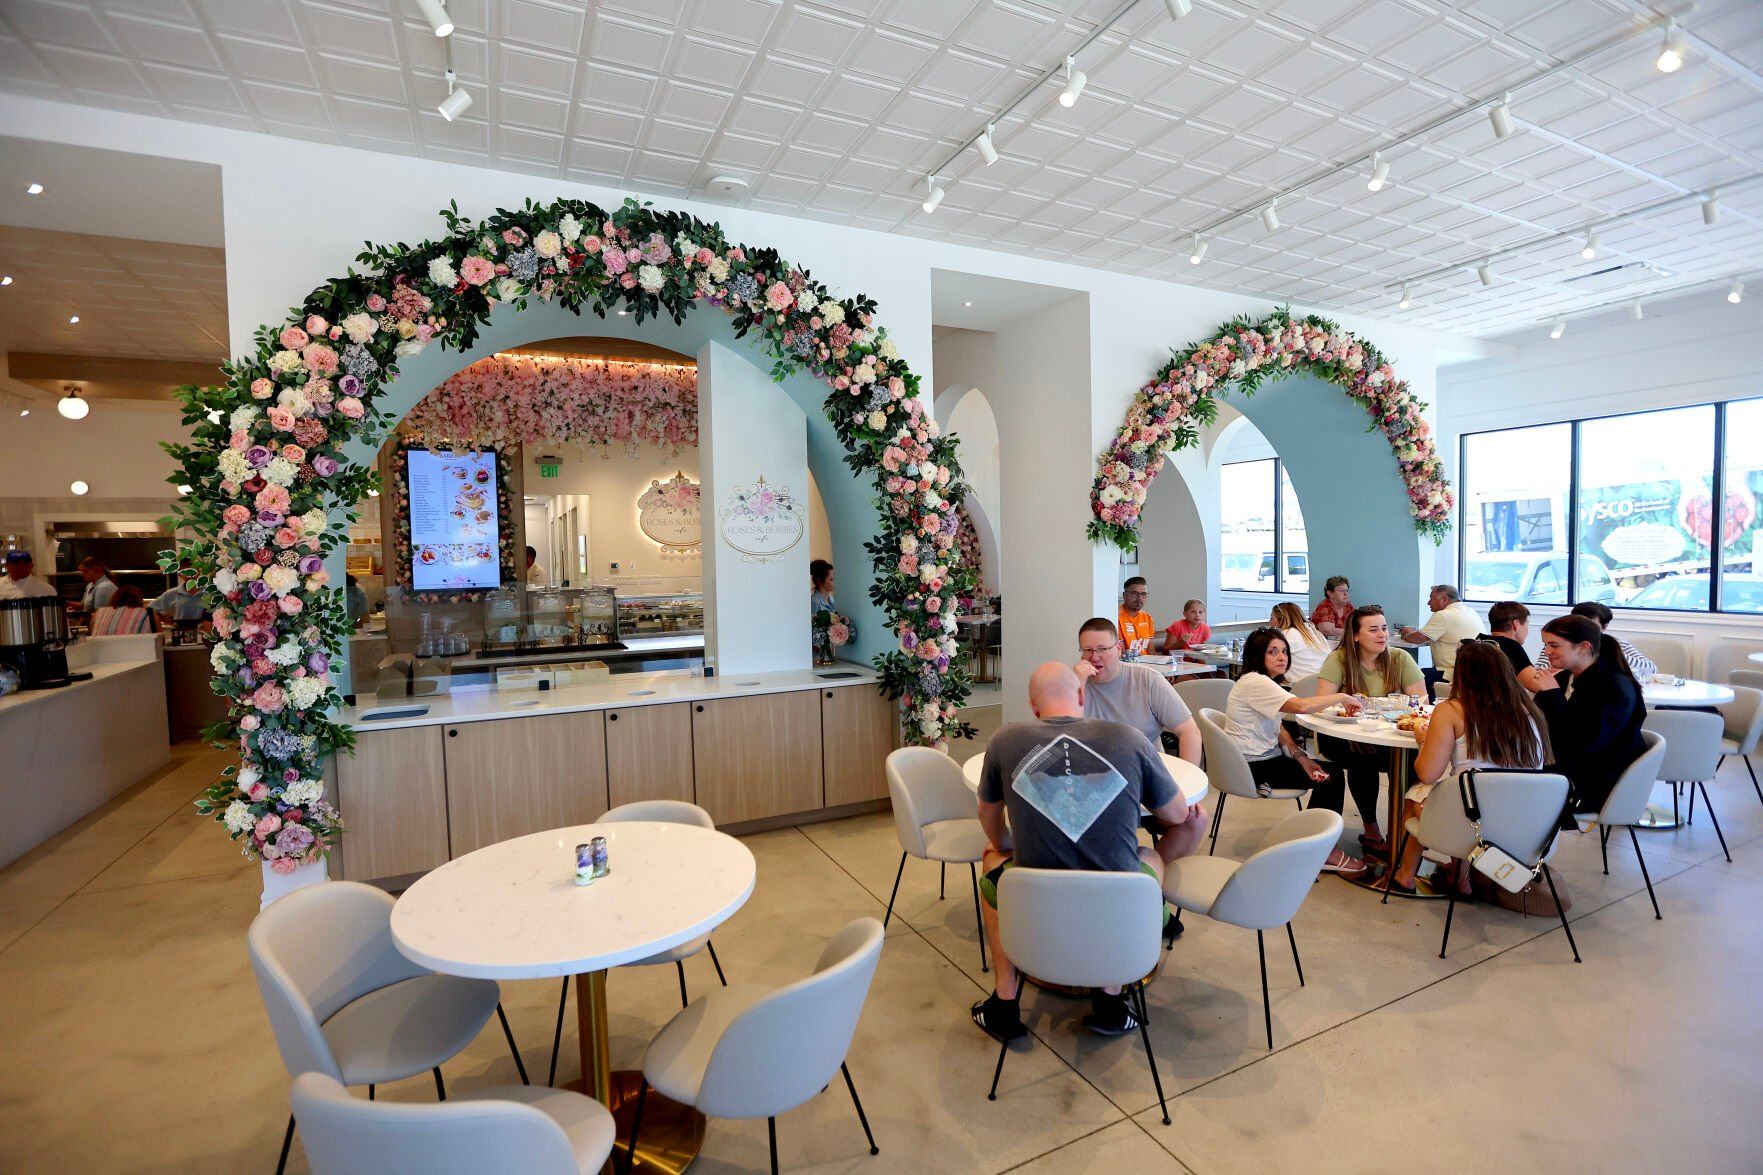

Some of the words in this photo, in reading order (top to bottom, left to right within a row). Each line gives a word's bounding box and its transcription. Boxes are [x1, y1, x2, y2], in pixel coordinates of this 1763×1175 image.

[541, 465, 558, 478] EXIT
[646, 518, 674, 526] ROSES
[727, 525, 756, 534] ROSES
[765, 525, 799, 534] BERRIES
